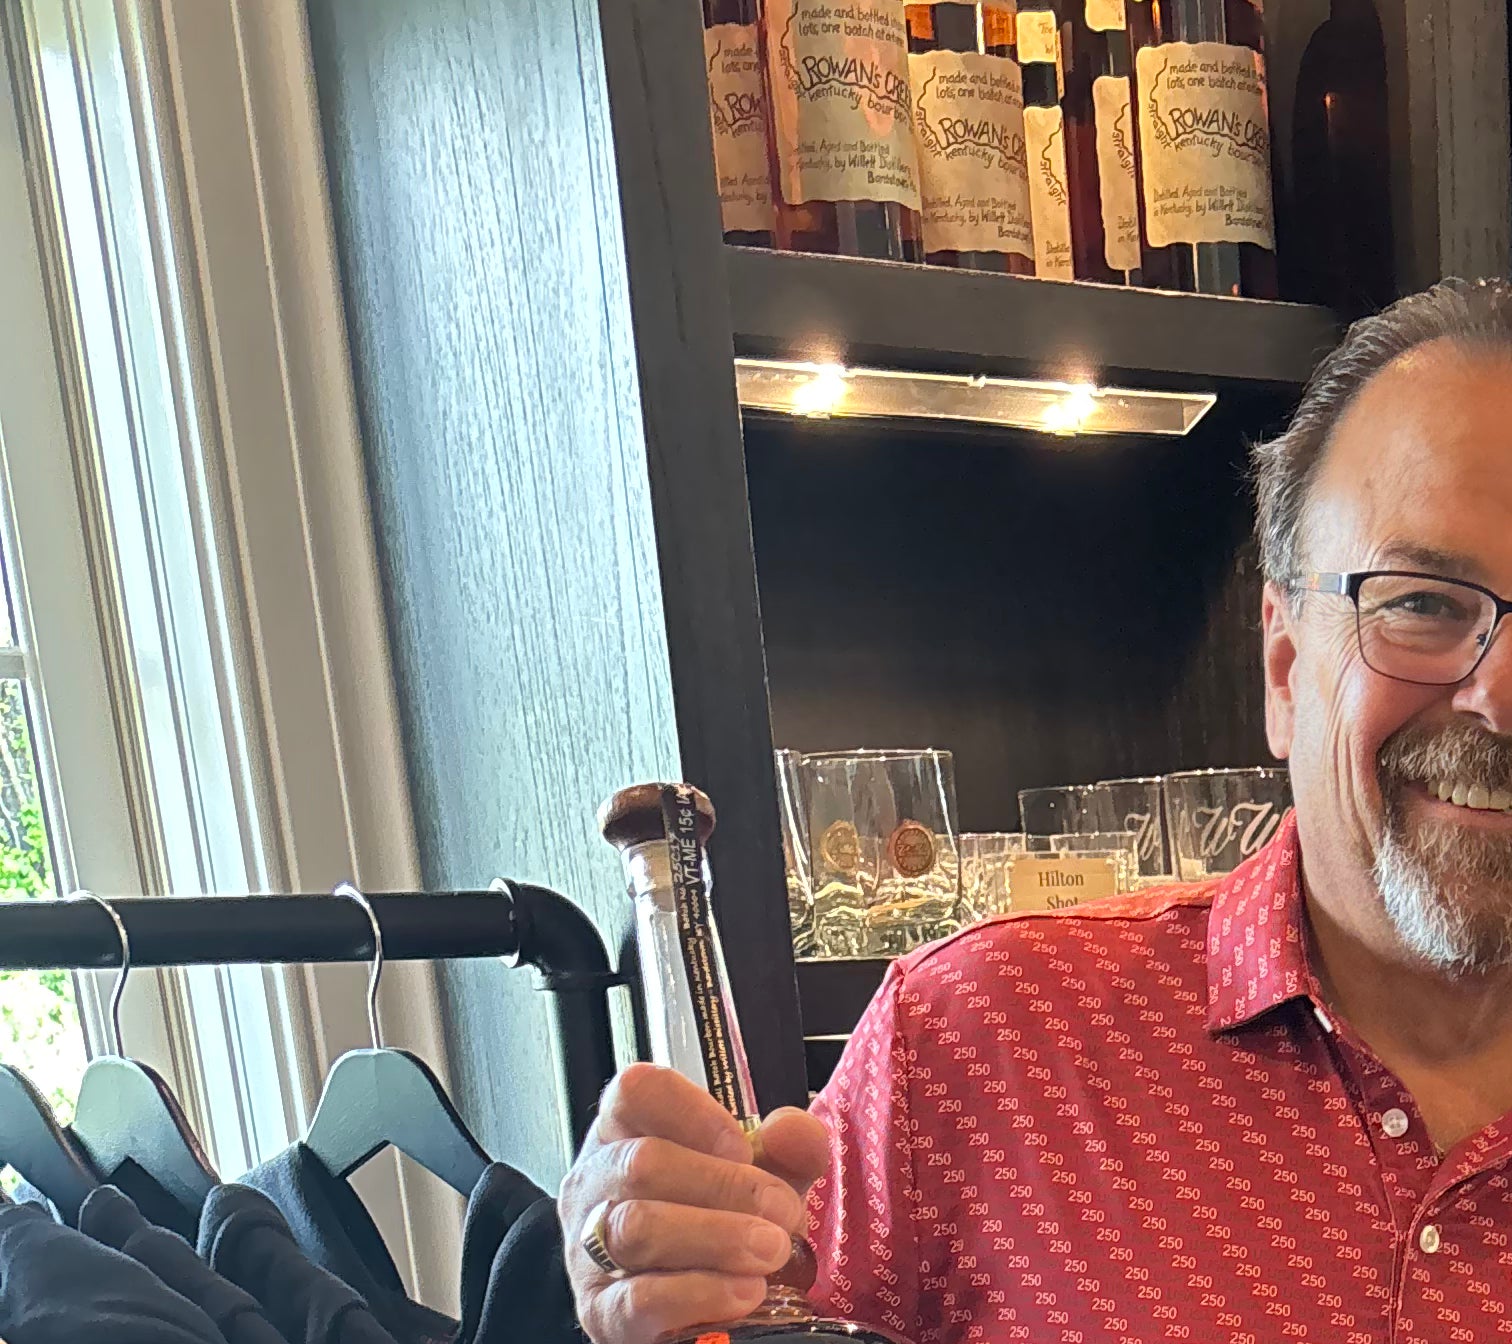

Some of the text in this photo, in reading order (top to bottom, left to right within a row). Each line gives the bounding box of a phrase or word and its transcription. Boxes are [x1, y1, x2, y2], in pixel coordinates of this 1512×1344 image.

[800, 5, 832, 20] made
[834, 6, 854, 19] and
[843, 22, 874, 39] batch
[1170, 60, 1198, 75] made
[1200, 62, 1218, 73] and
[938, 70, 967, 84] made
[969, 73, 988, 85] and
[1208, 77, 1236, 89] batch
[809, 85, 862, 110] kentucky
[1174, 134, 1224, 158] kentucky
[945, 144, 994, 170] kentucky
[1038, 870, 1084, 887] Hilton
[908, 1002, 932, 1017] 250
[1167, 1041, 1193, 1055] 250
[1024, 1132, 1048, 1146] 250
[1395, 1140, 1419, 1156] 250
[922, 1276, 948, 1291] 250
[1199, 1293, 1226, 1308] 250
